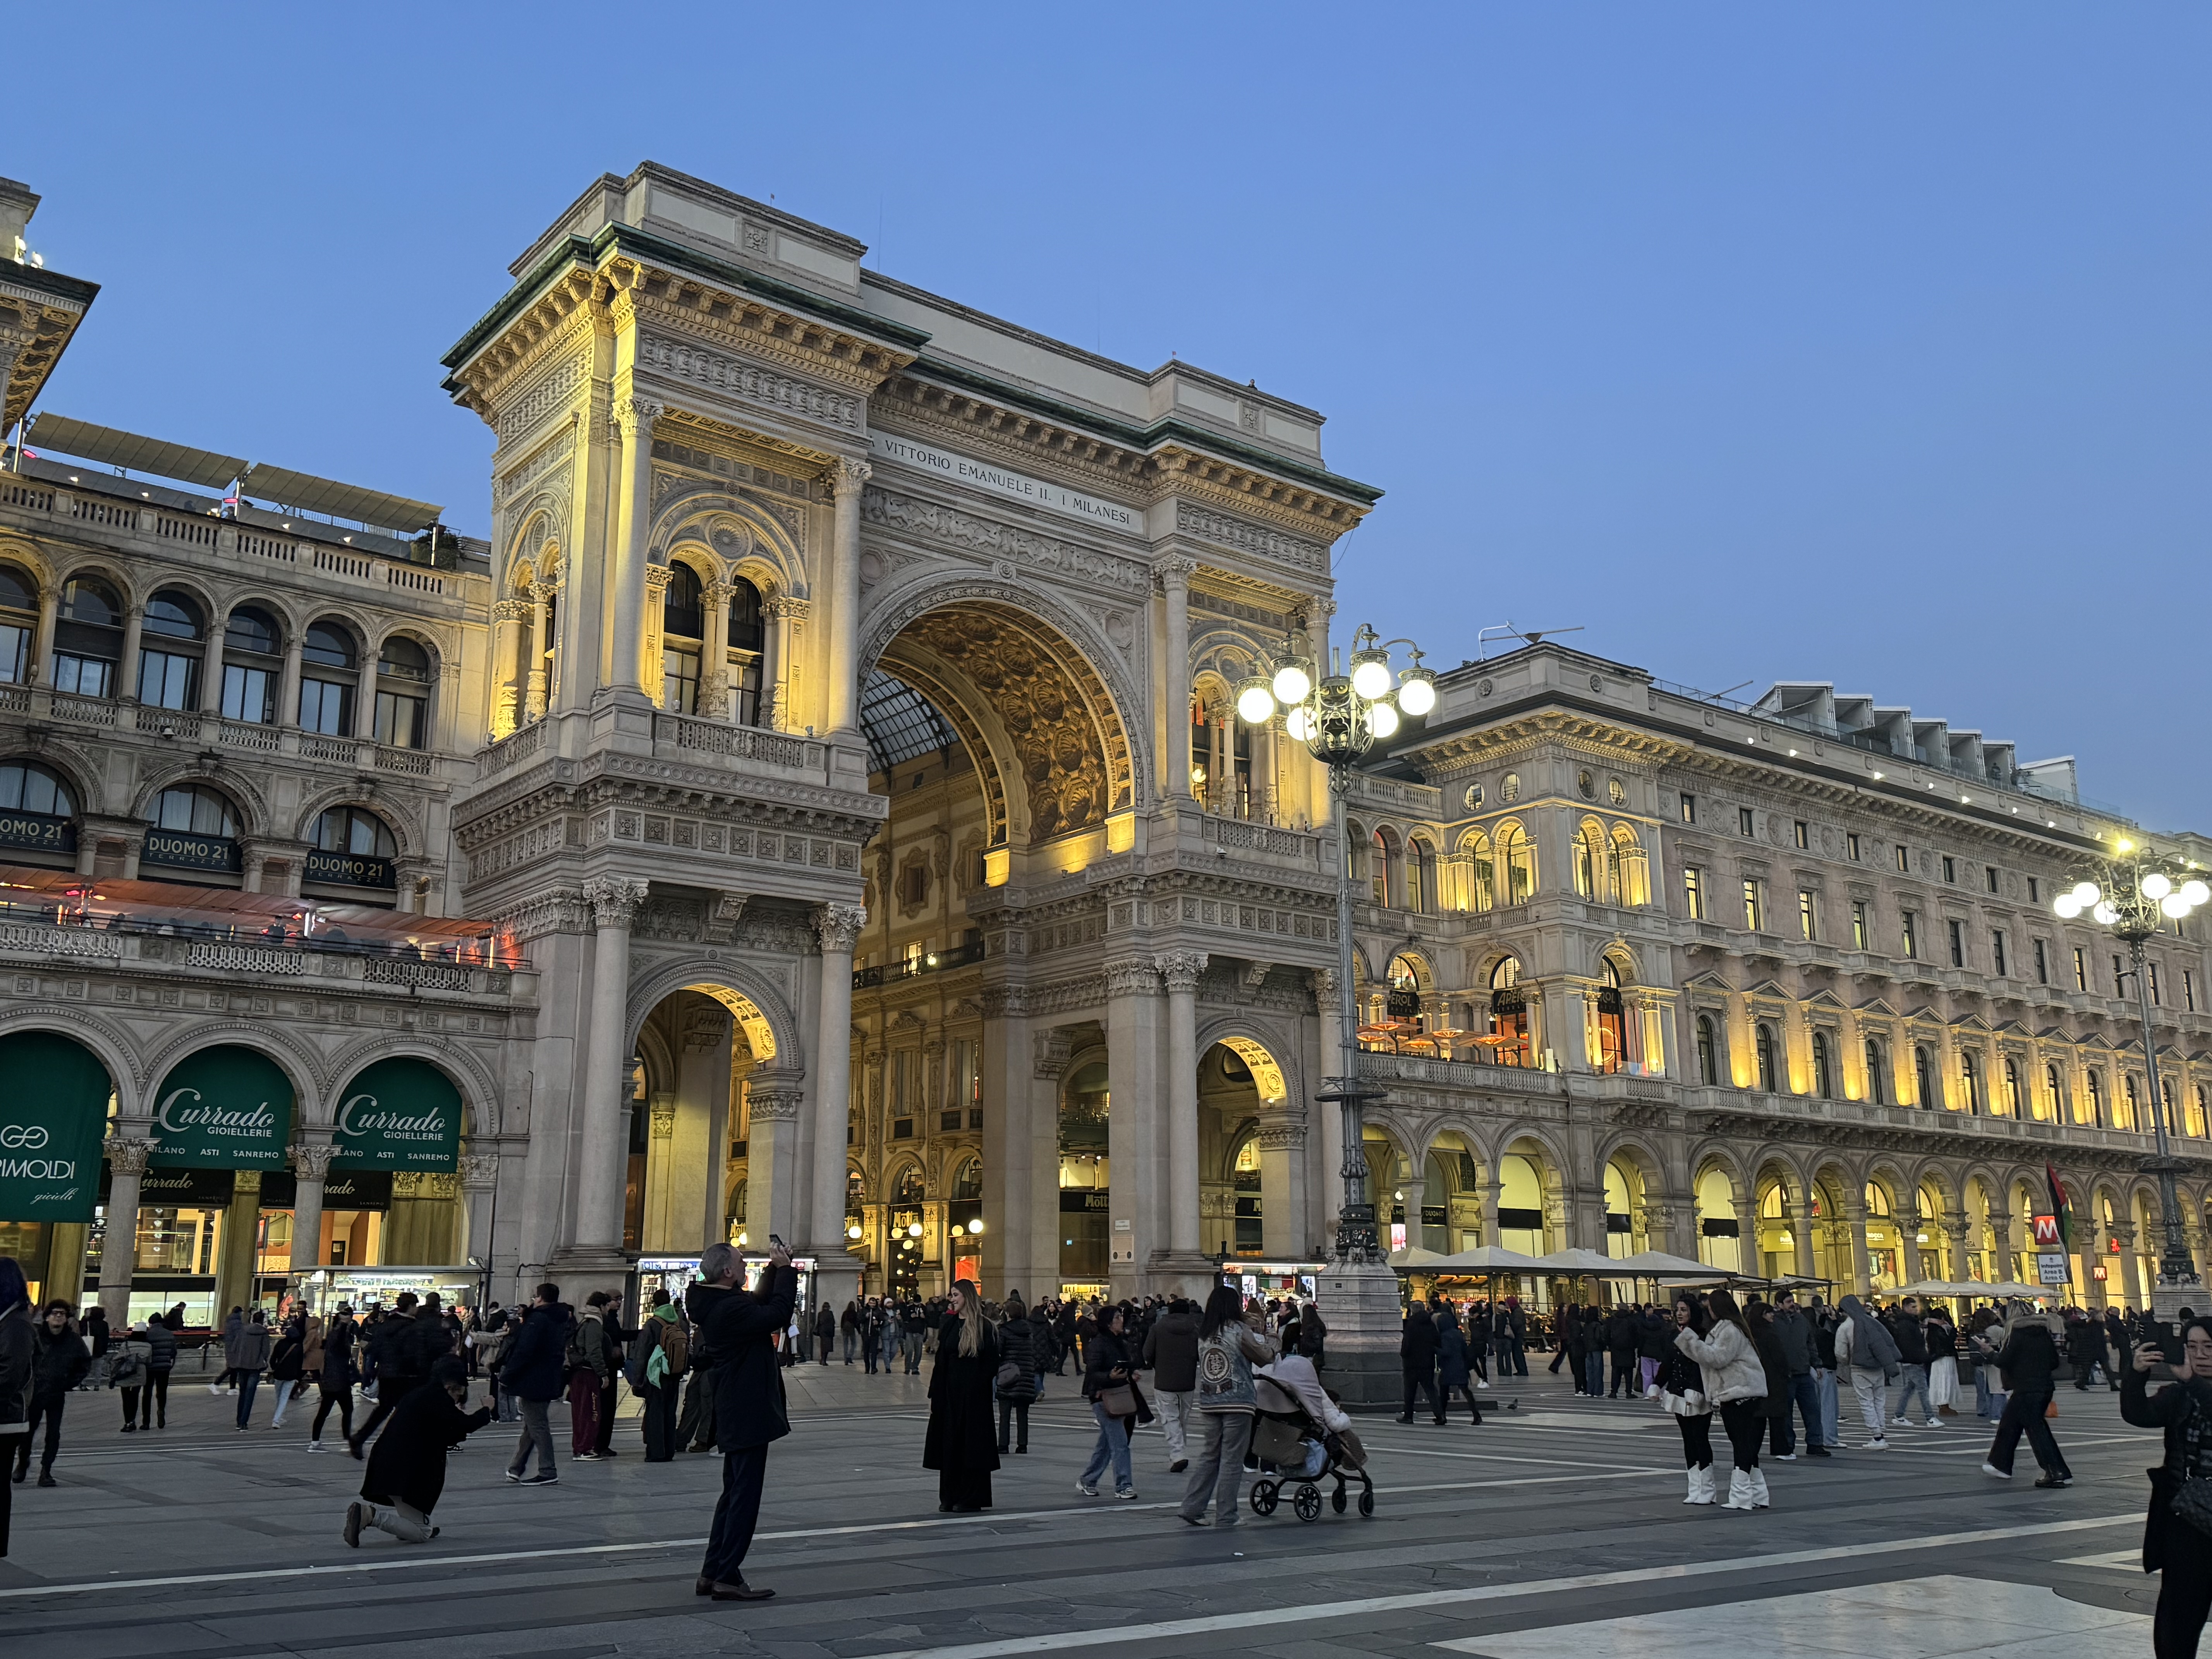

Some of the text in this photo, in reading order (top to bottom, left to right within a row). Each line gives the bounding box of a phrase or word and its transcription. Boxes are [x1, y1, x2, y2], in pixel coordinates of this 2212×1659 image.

[885, 440, 950, 469] VITTORIO
[959, 463, 1032, 495] EMANUELE
[1062, 494, 1065, 505] I
[1073, 498, 1130, 524] MILANESI
[0, 819, 62, 839] OMO 21
[149, 837, 228, 859] DUOMO 21
[149, 853, 227, 866] TERRAZZA
[310, 856, 383, 877] DUOMO 21
[310, 871, 381, 884] TERRAZZA
[1391, 994, 1412, 1006] EROL
[1498, 991, 1526, 1006] APER
[159, 1088, 275, 1132] Currado
[339, 1094, 445, 1136] Currado
[207, 1126, 272, 1137] GIOIELLERIE
[383, 1131, 444, 1141] GIOIELLERIE
[232, 1150, 279, 1158] SANREMO
[0, 1158, 75, 1179] IMOLDI
[322, 1179, 355, 1194] rado
[30, 1187, 79, 1205] gioielli
[1085, 1194, 1109, 1207] Mott
[730, 1222, 746, 1238] Mott
[2037, 1219, 2059, 1239] M
[2094, 1269, 2106, 1278] M
